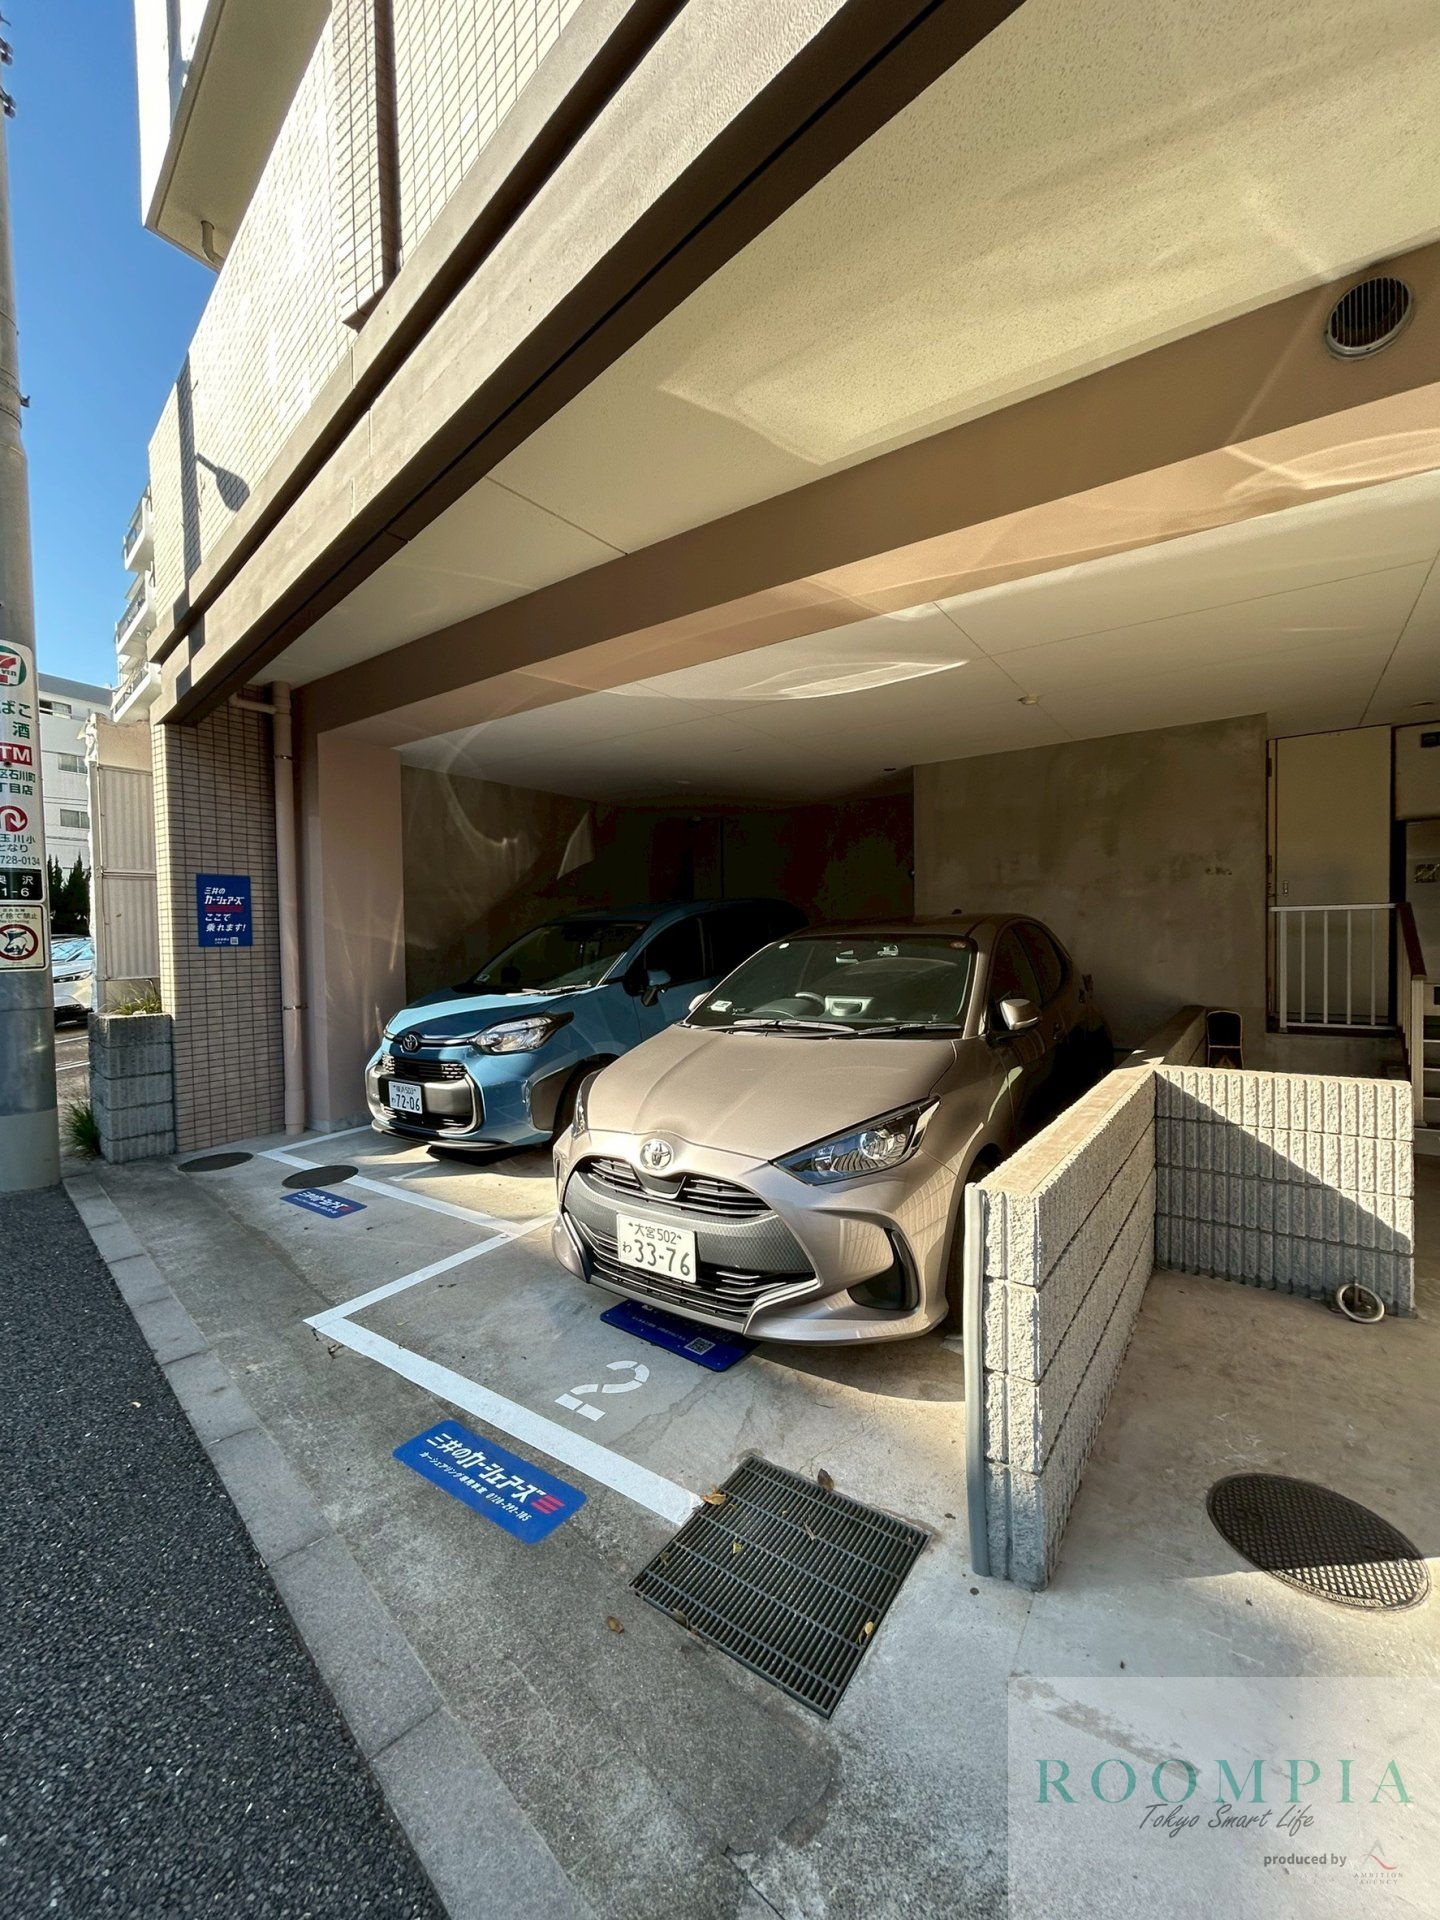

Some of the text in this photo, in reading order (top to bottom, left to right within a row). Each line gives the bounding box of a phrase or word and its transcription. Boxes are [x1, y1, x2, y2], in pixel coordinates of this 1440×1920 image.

[0, 700, 32, 719] ばこ
[13, 721, 31, 740] 酒
[204, 887, 225, 895] 三井の
[205, 913, 231, 922] ここで
[396, 1094, 420, 1111] 72-06
[622, 1238, 690, 1277] わ 33-76
